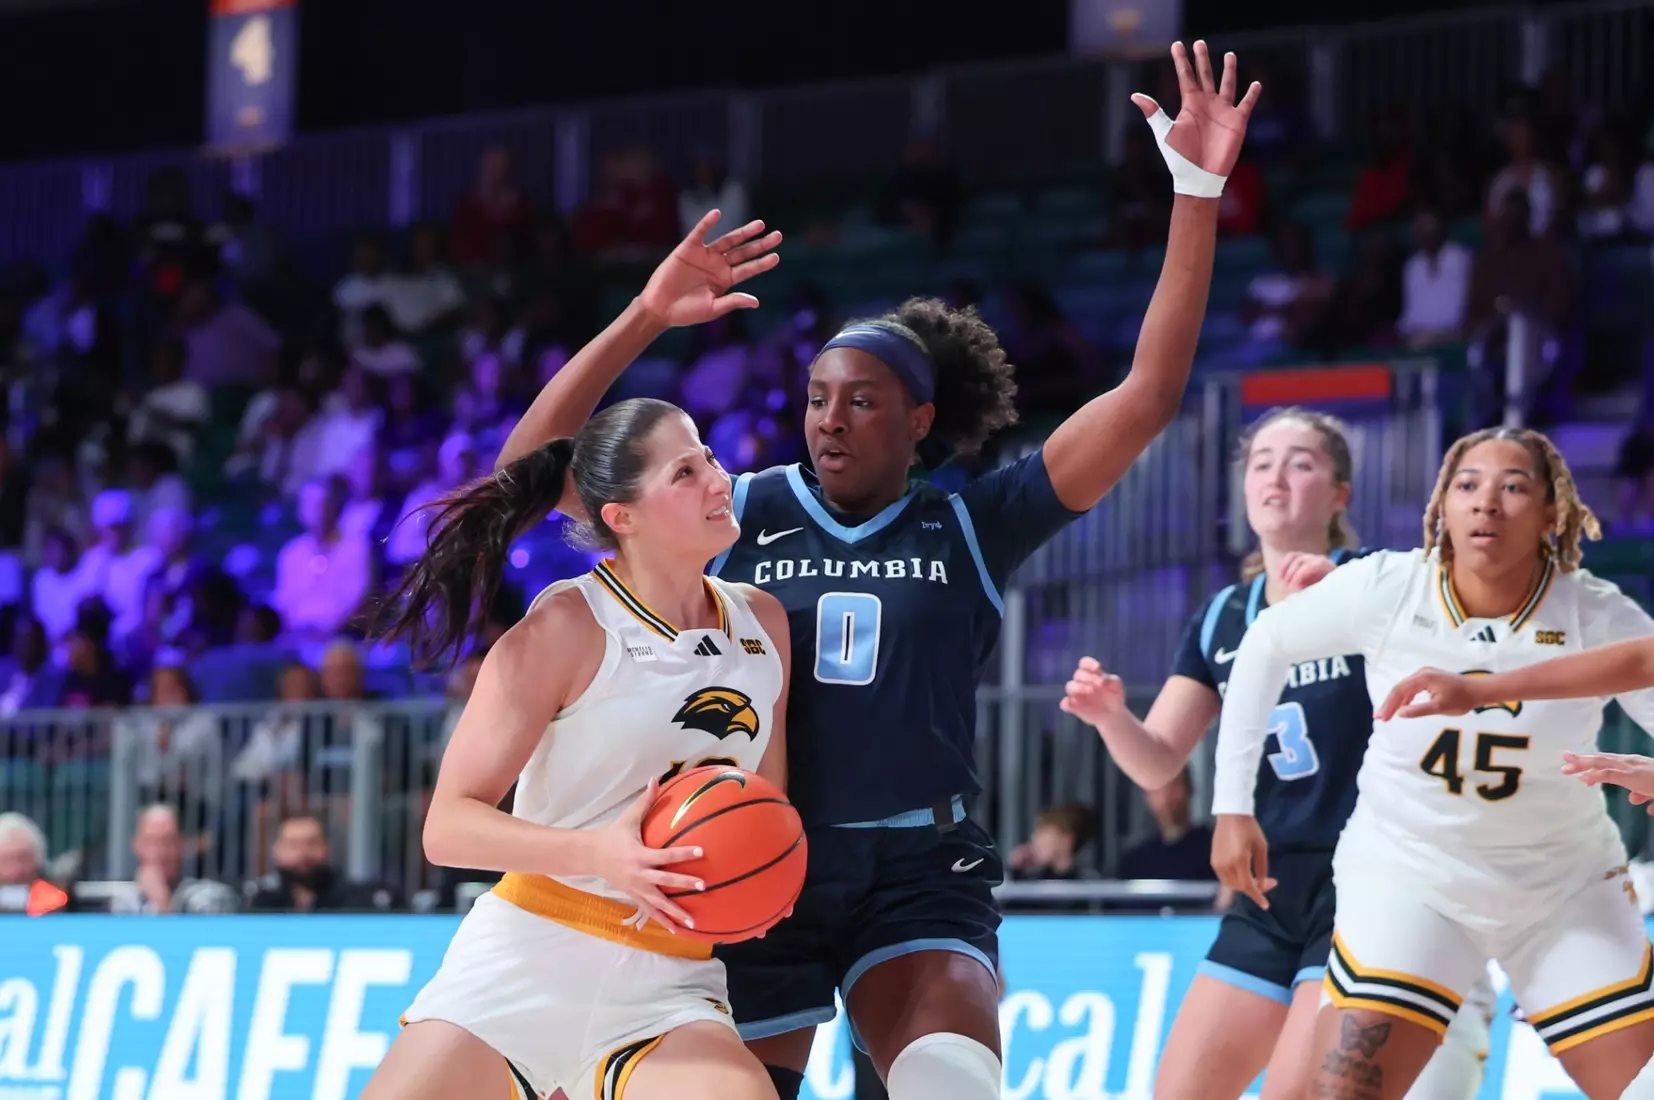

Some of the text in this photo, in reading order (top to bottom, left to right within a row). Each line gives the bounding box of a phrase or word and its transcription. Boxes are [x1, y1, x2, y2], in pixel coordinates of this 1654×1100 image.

[229, 15, 272, 87] 4
[754, 558, 948, 585] COLUMBIA
[814, 592, 882, 686] 0
[1266, 701, 1320, 781] 3
[1419, 727, 1531, 803] 45
